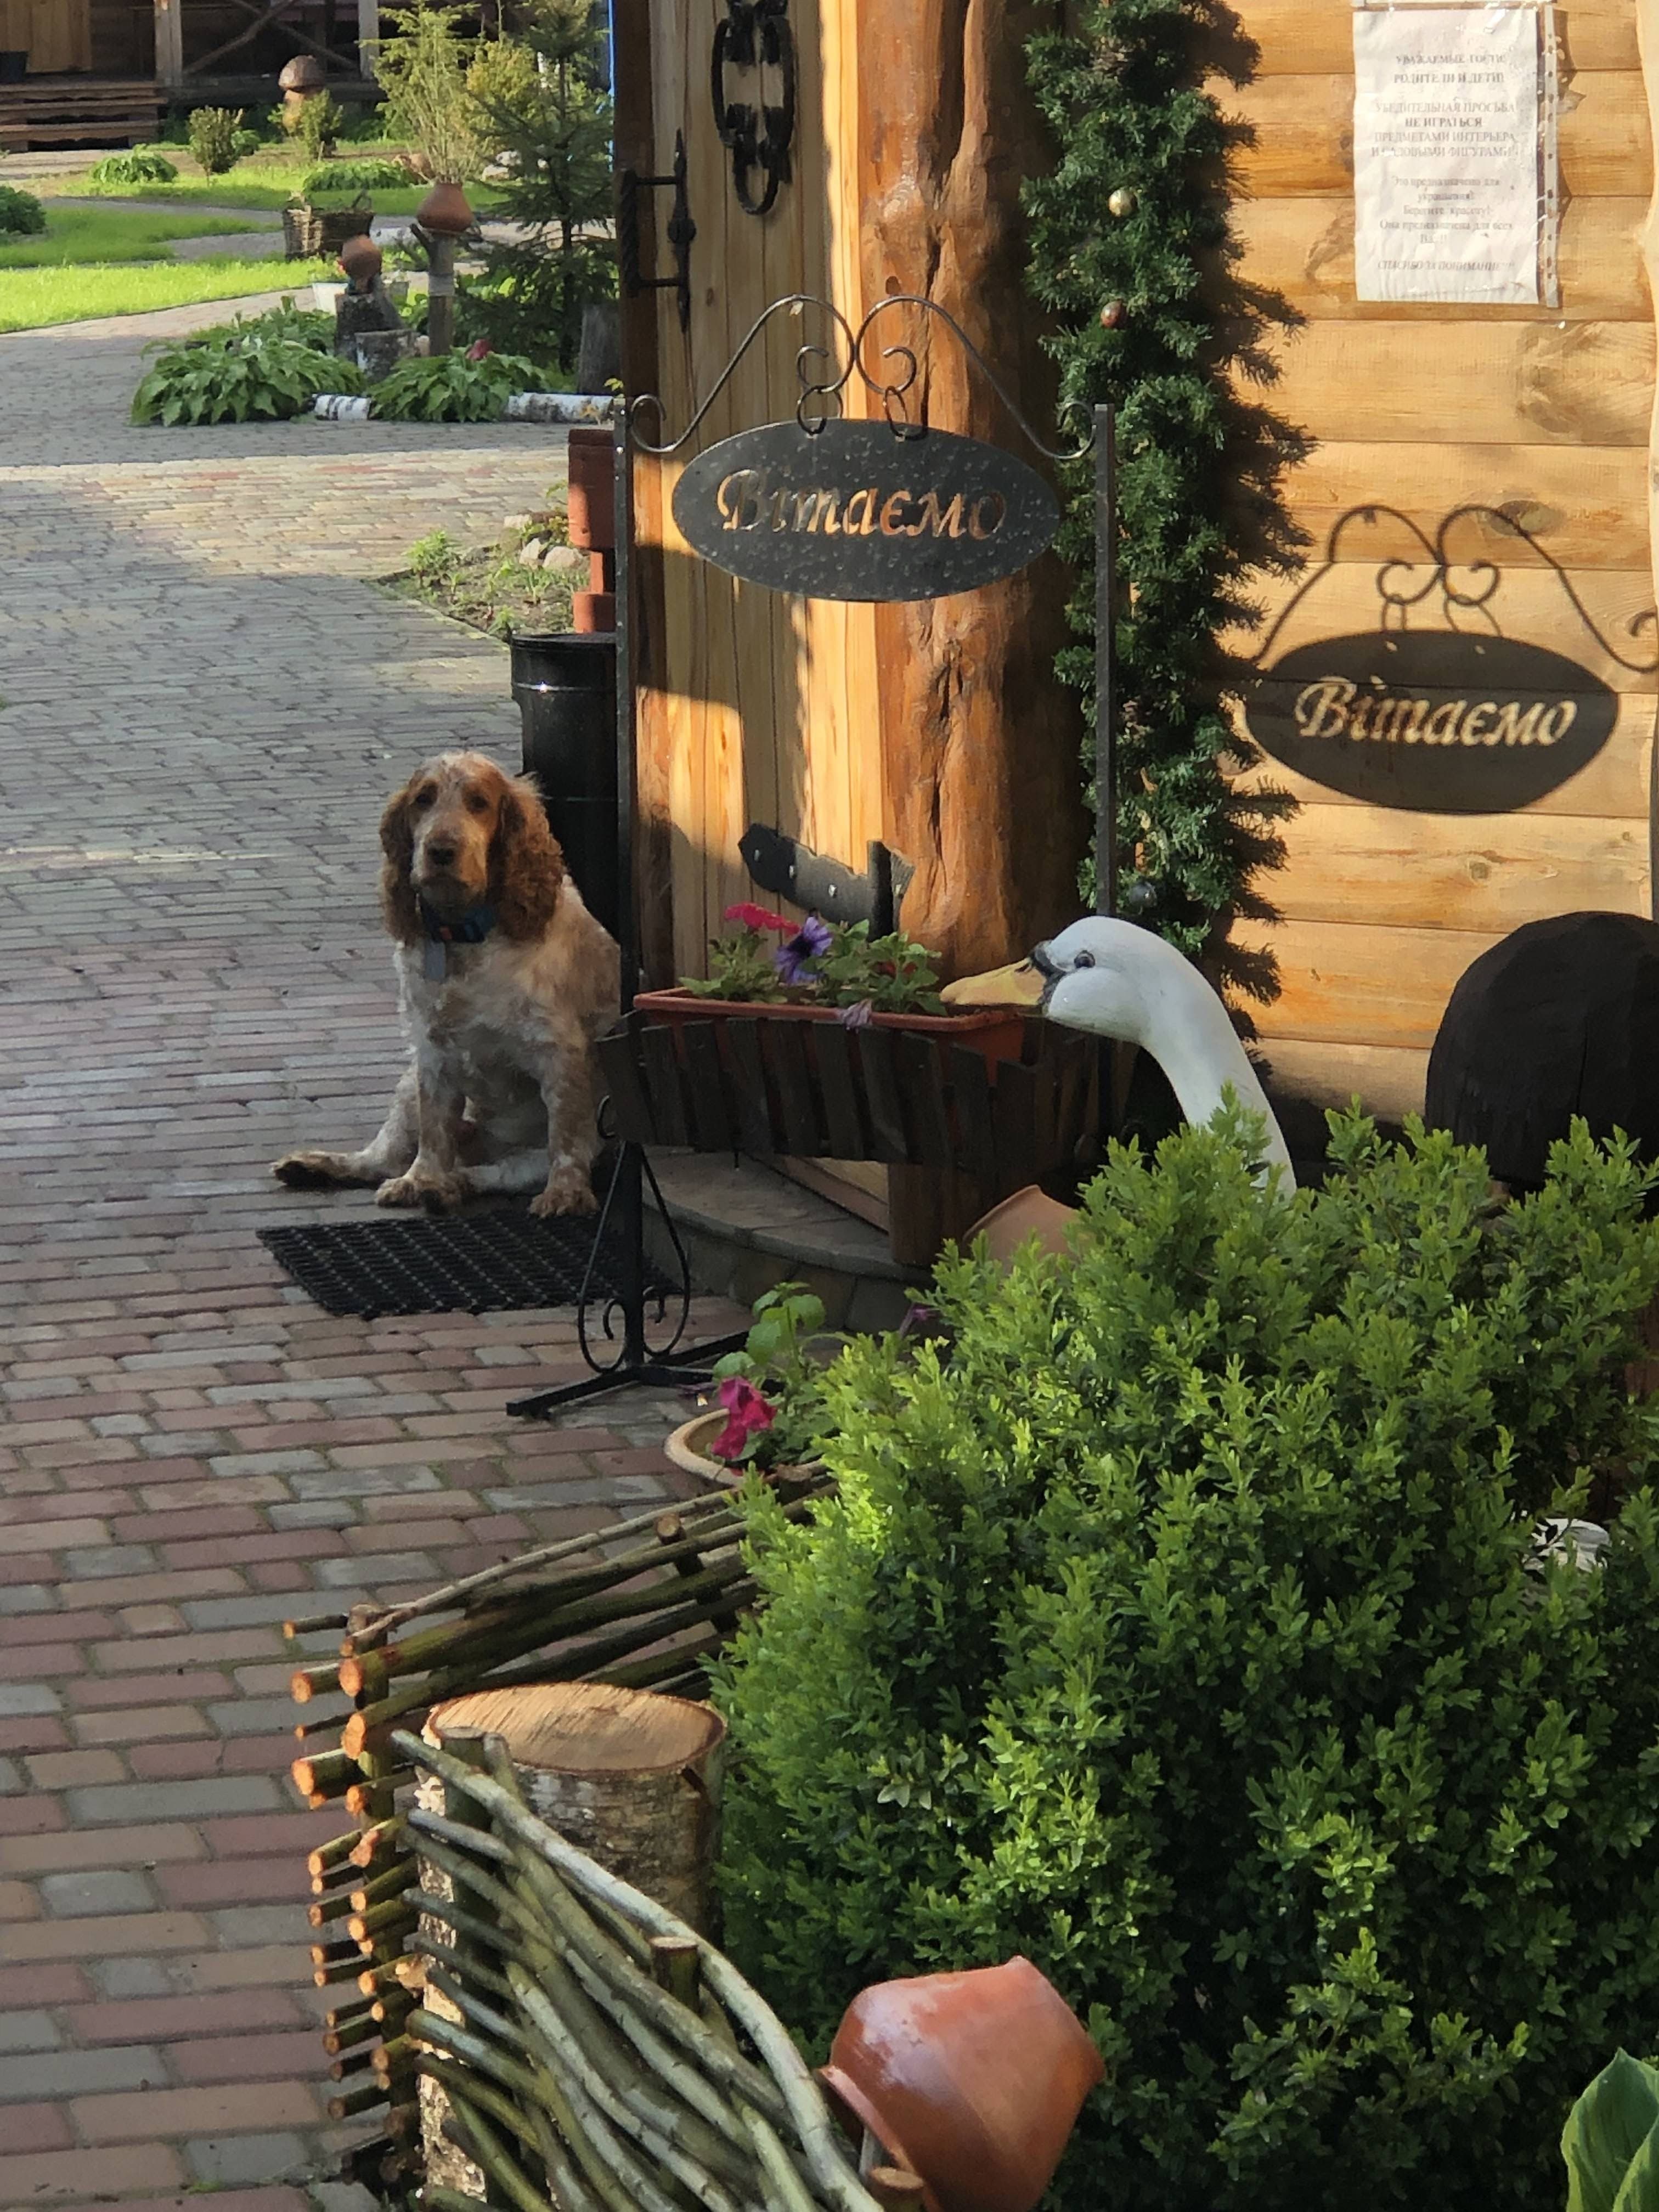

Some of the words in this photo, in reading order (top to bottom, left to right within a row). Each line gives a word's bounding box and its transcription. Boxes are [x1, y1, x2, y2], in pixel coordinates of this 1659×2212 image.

[1393, 74, 1455, 84] РОДИТЕЛИ
[1458, 72, 1466, 83] И
[1376, 102, 1462, 113] УБЕДИТЕЛЬНАЯ
[1464, 102, 1515, 112] ПРОСЬБА
[1405, 117, 1421, 127] НЕ
[1424, 117, 1483, 127] ИГРАТЬСЯ
[1374, 131, 1449, 142] ПРЕДМЕТАМИ
[1372, 147, 1379, 157] И
[1381, 146, 1446, 157] ДОВЫМИ
[1378, 261, 1424, 270] СПАСИБО
